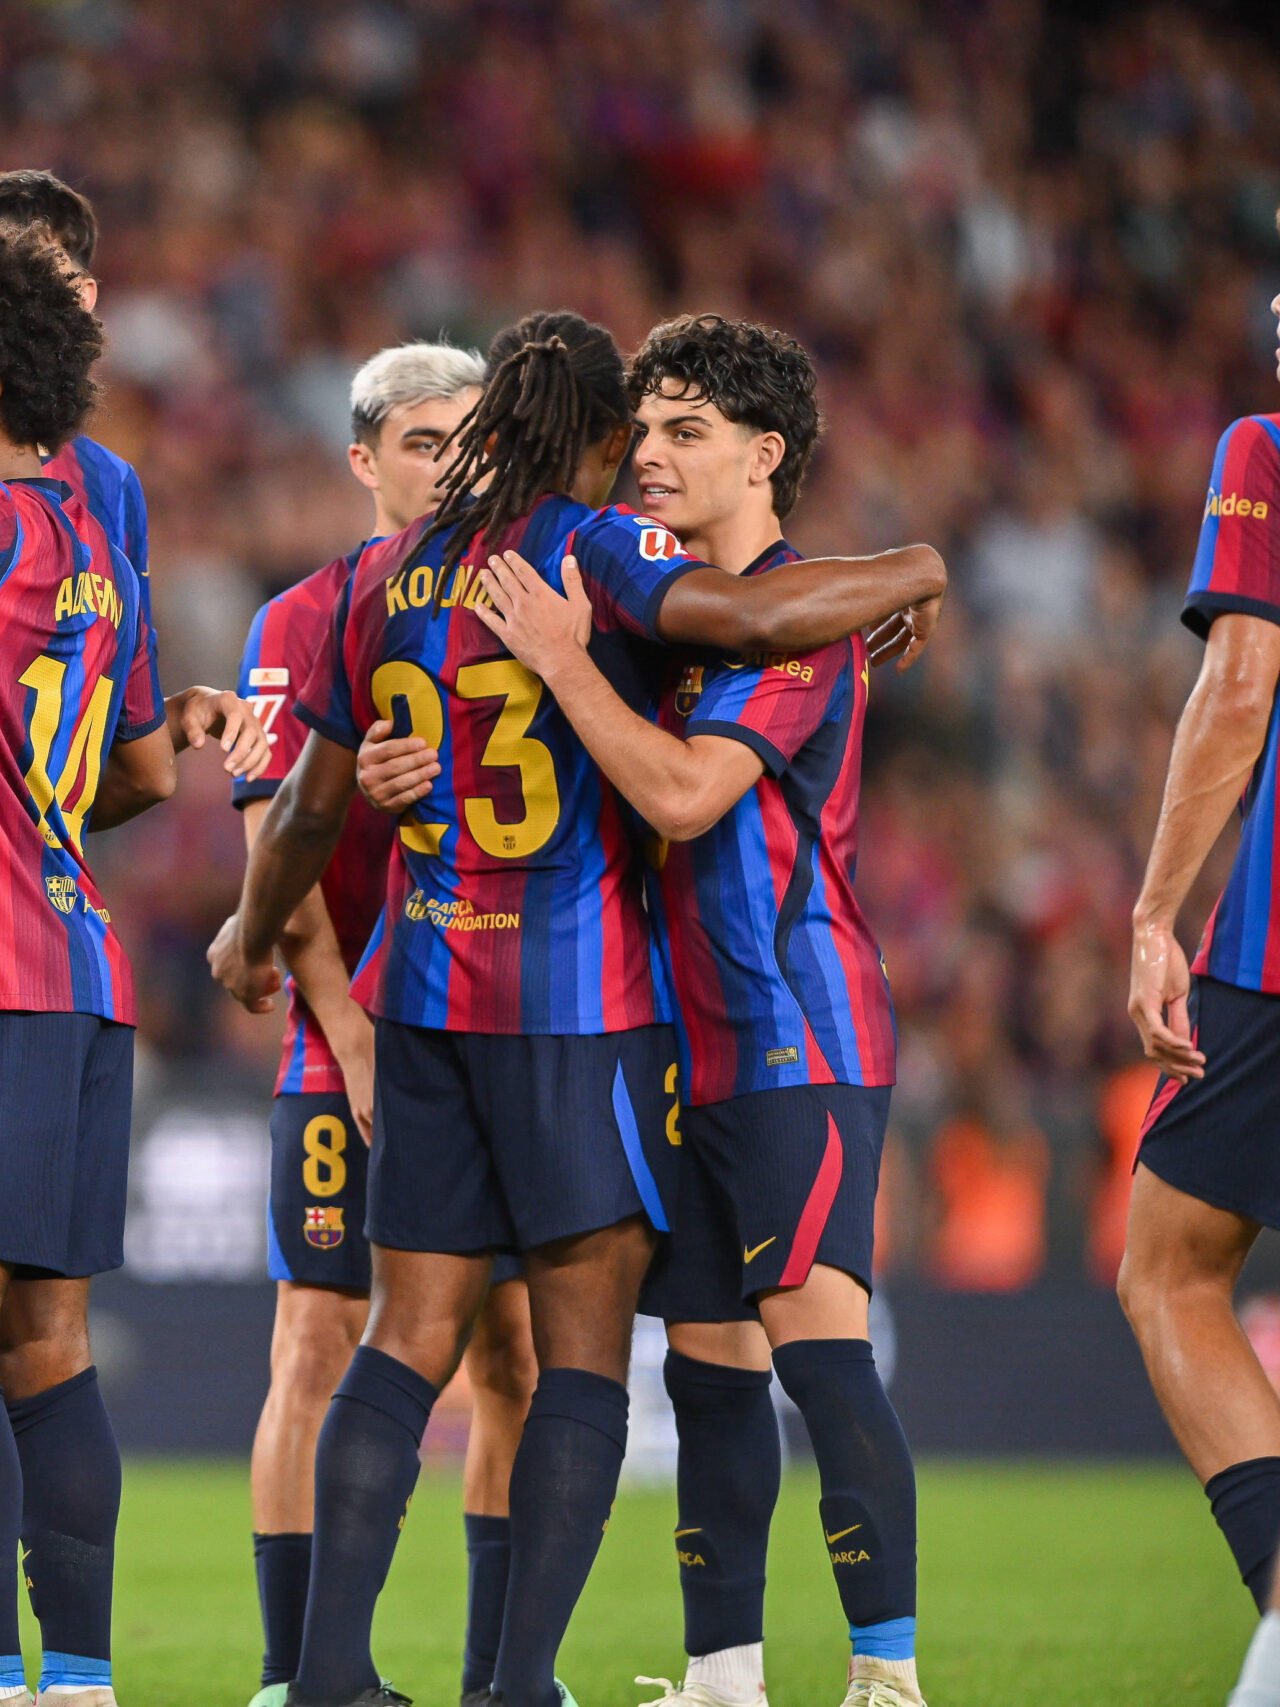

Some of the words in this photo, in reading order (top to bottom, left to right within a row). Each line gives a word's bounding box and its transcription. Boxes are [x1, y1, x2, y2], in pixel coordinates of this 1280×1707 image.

[385, 564, 495, 618] KOUND
[17, 654, 115, 860] 14
[371, 658, 561, 859] 23
[425, 898, 475, 917] BARÇA
[302, 1114, 347, 1198] 8
